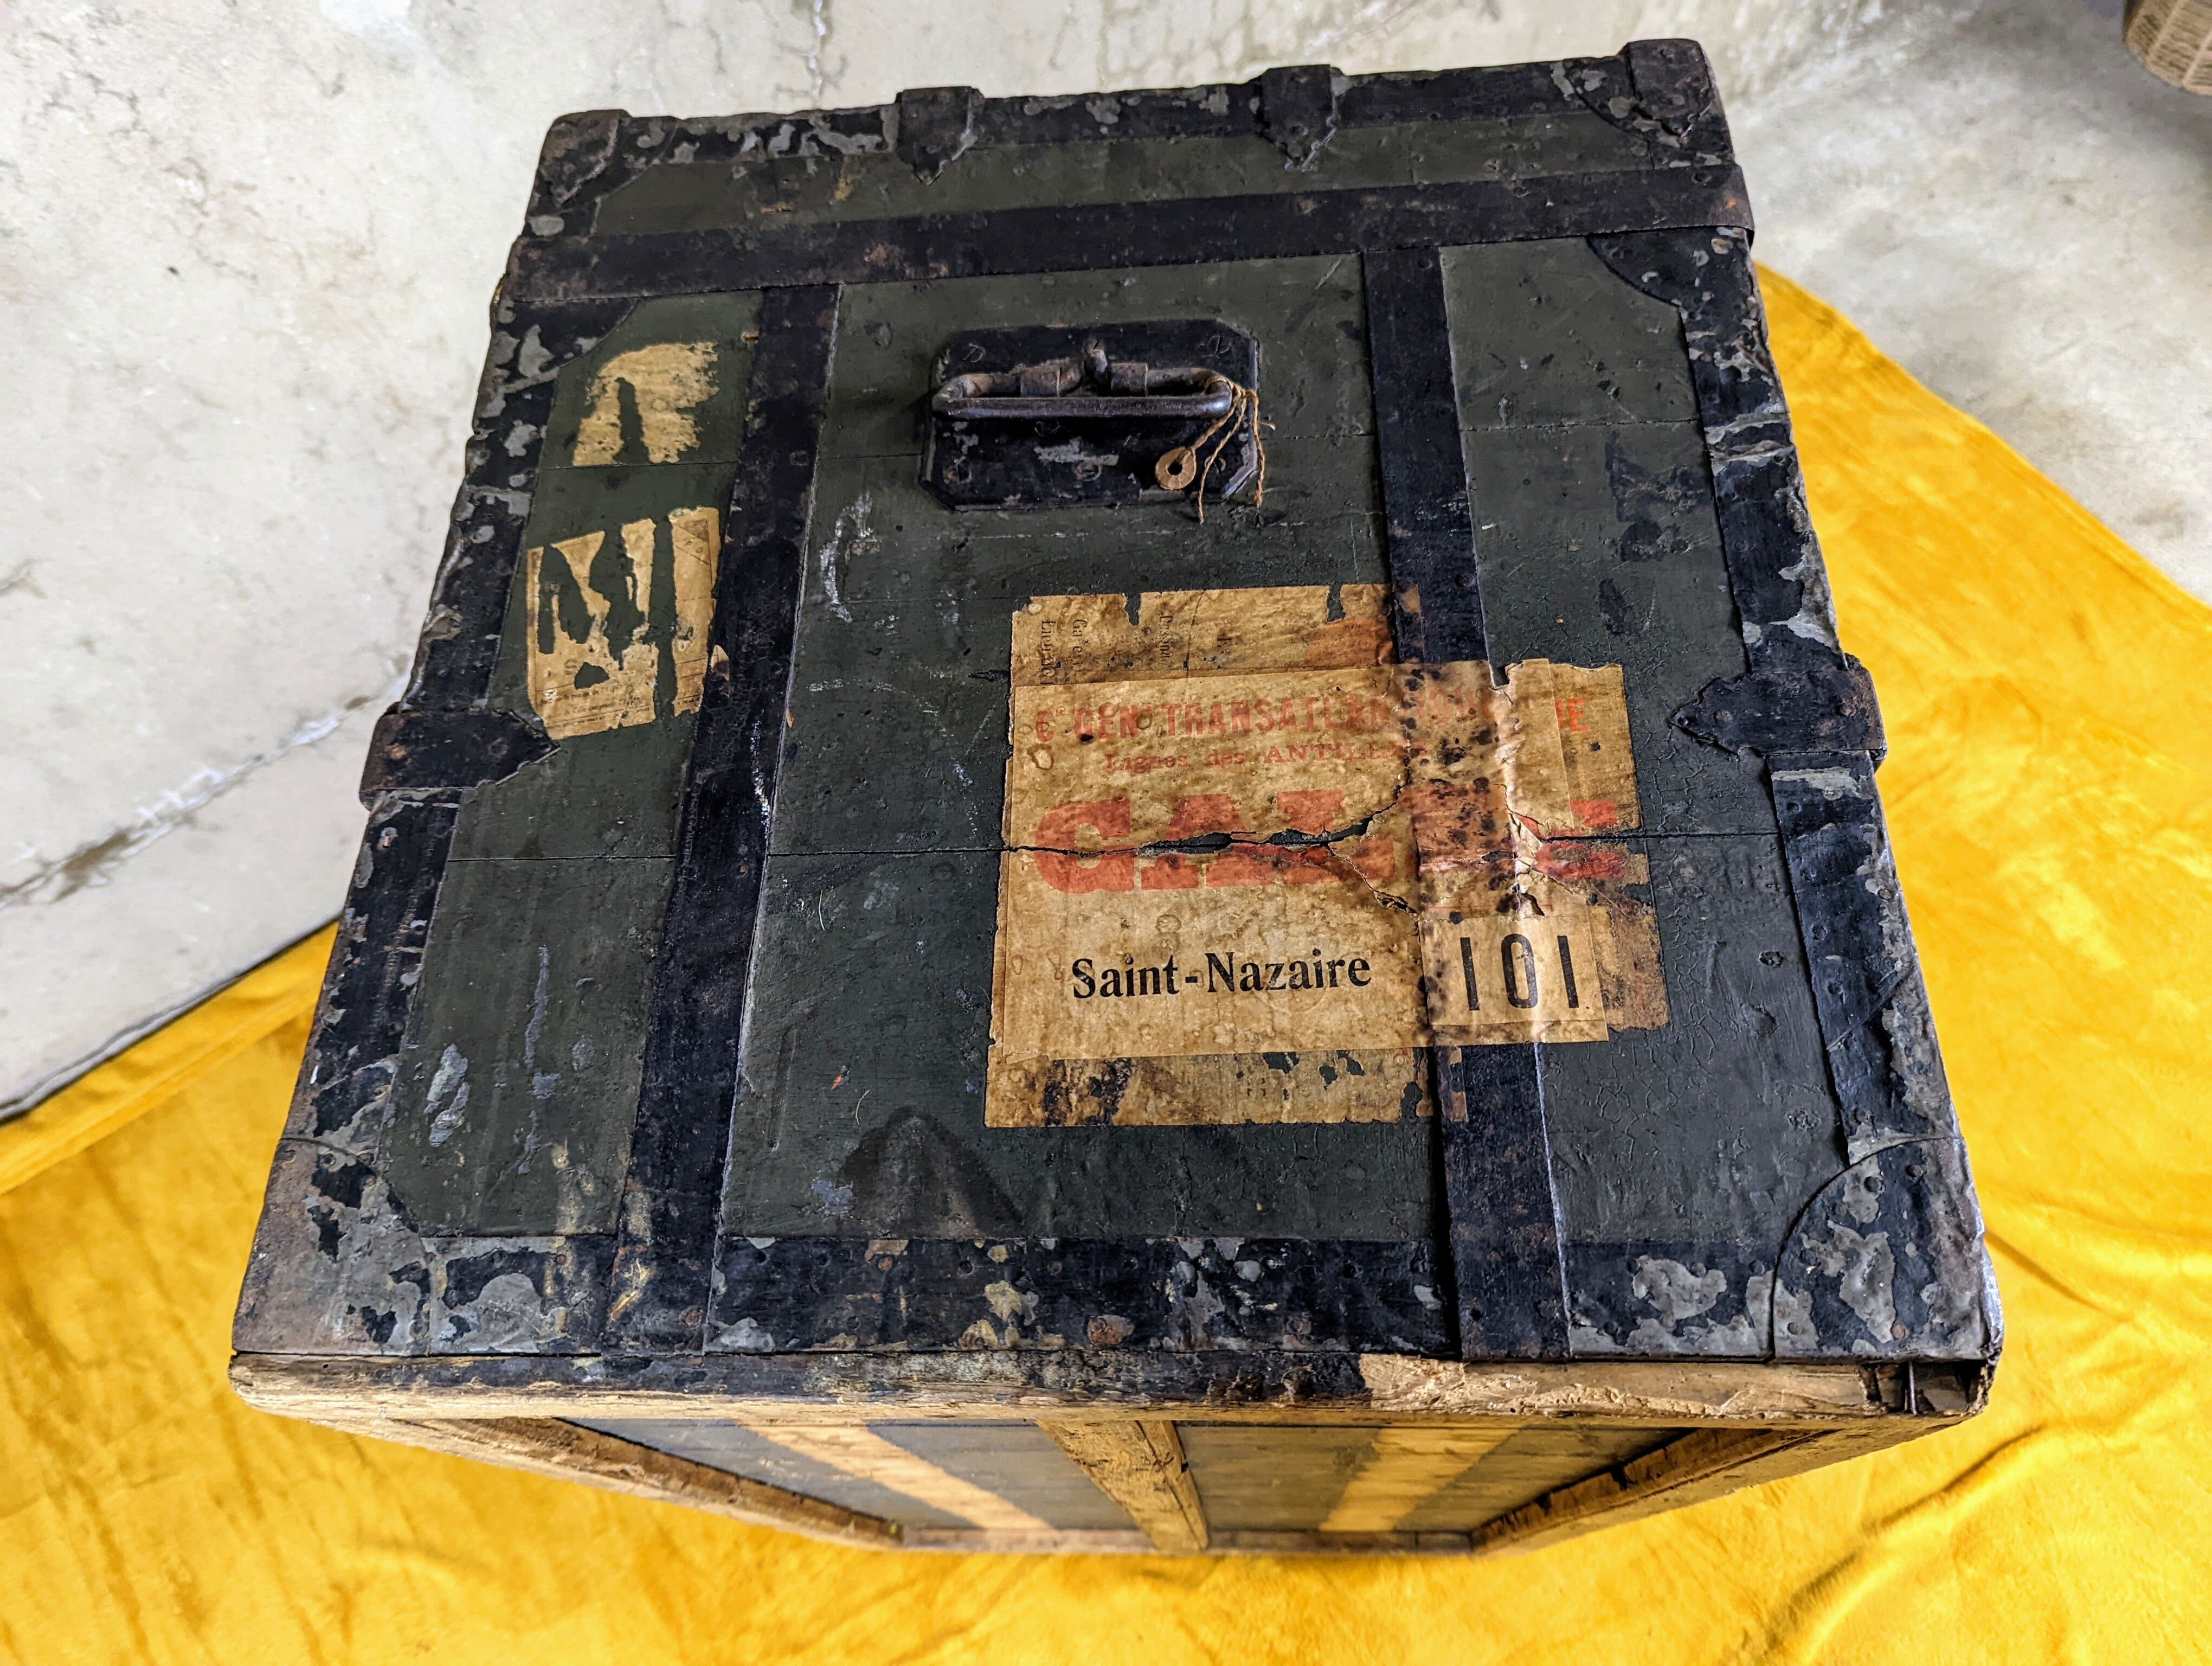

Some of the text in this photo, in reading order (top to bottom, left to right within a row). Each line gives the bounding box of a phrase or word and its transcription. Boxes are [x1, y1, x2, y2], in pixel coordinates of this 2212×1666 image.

[1104, 752, 1188, 774] Lignes
[1205, 747, 1246, 767] des
[1071, 949, 1372, 1000] Saint-Nazaire
[1459, 933, 1580, 1011] 101
